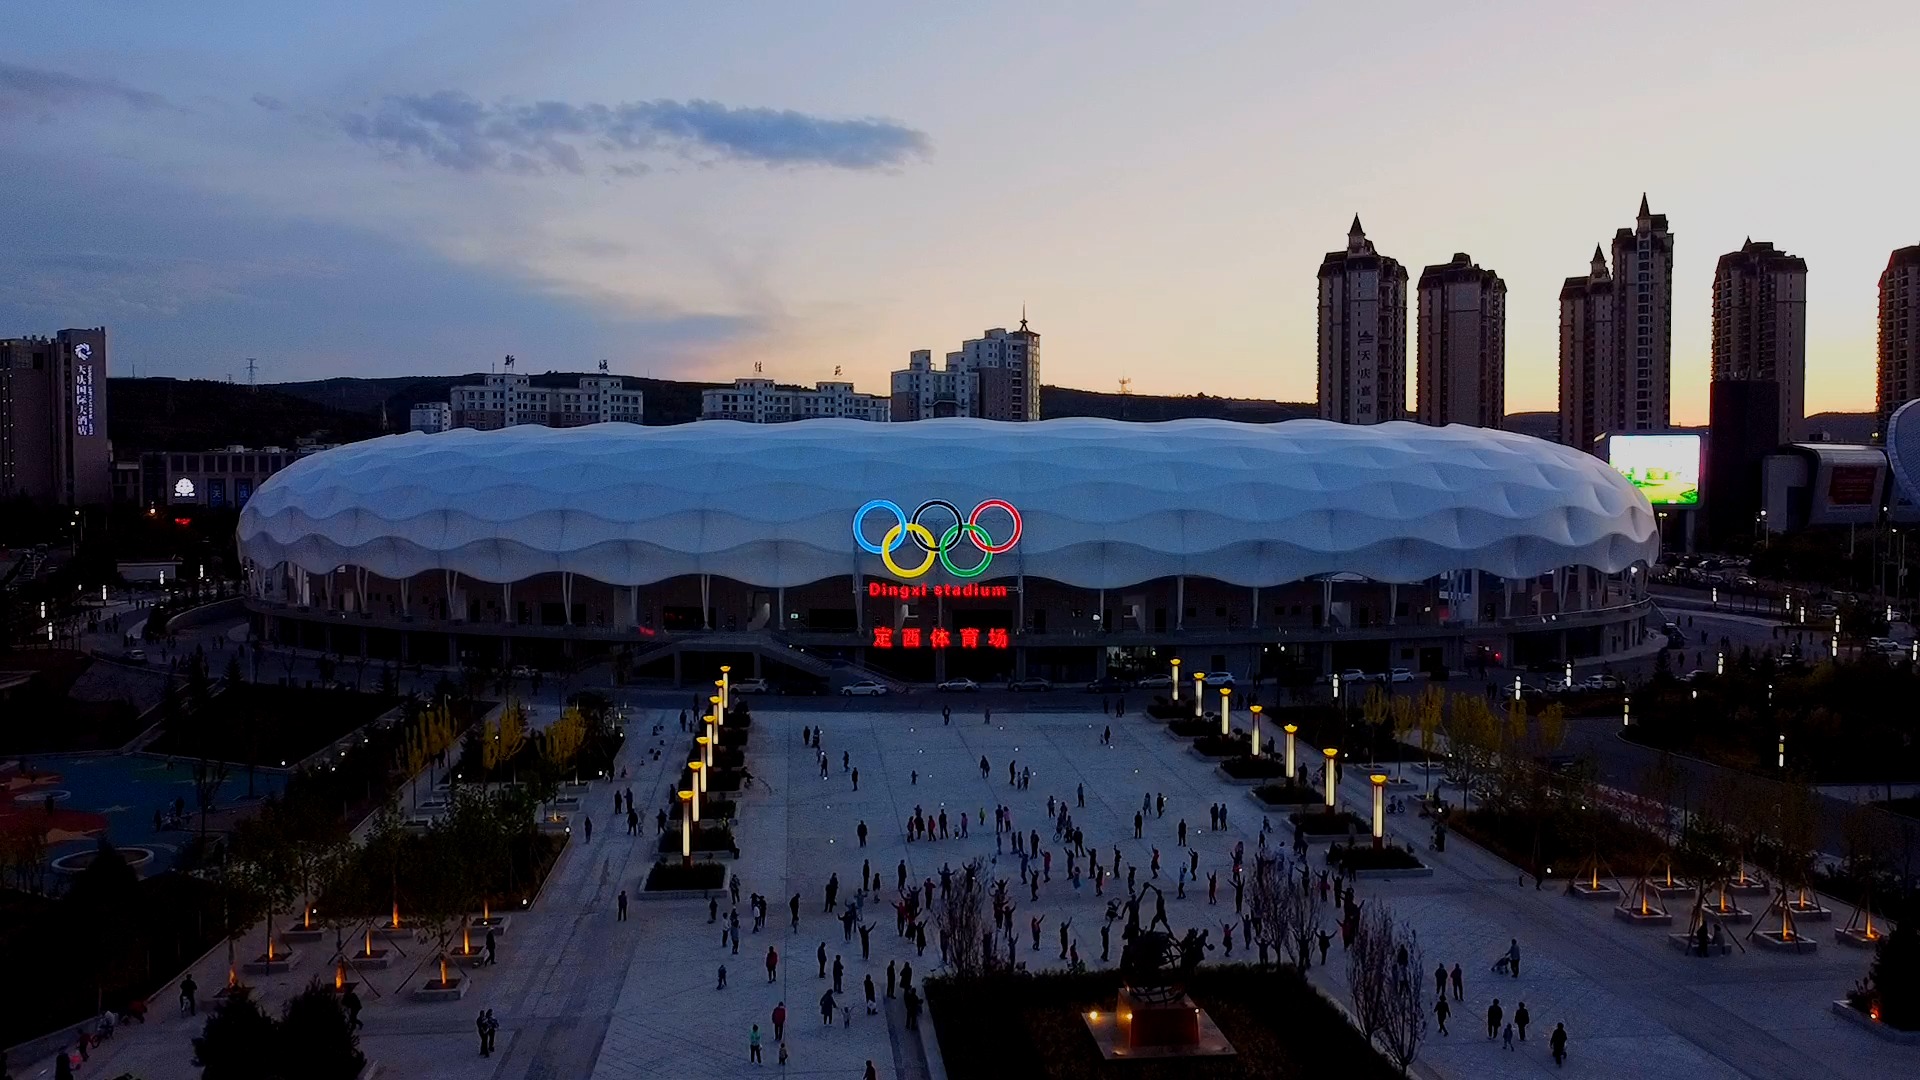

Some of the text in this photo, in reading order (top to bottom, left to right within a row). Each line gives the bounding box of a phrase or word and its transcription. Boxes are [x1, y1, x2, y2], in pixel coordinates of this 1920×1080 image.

[76, 365, 88, 436] 天庆国际大酒店
[869, 582, 1007, 599] Dingxi stadium
[873, 627, 1009, 648] 定西体育场
